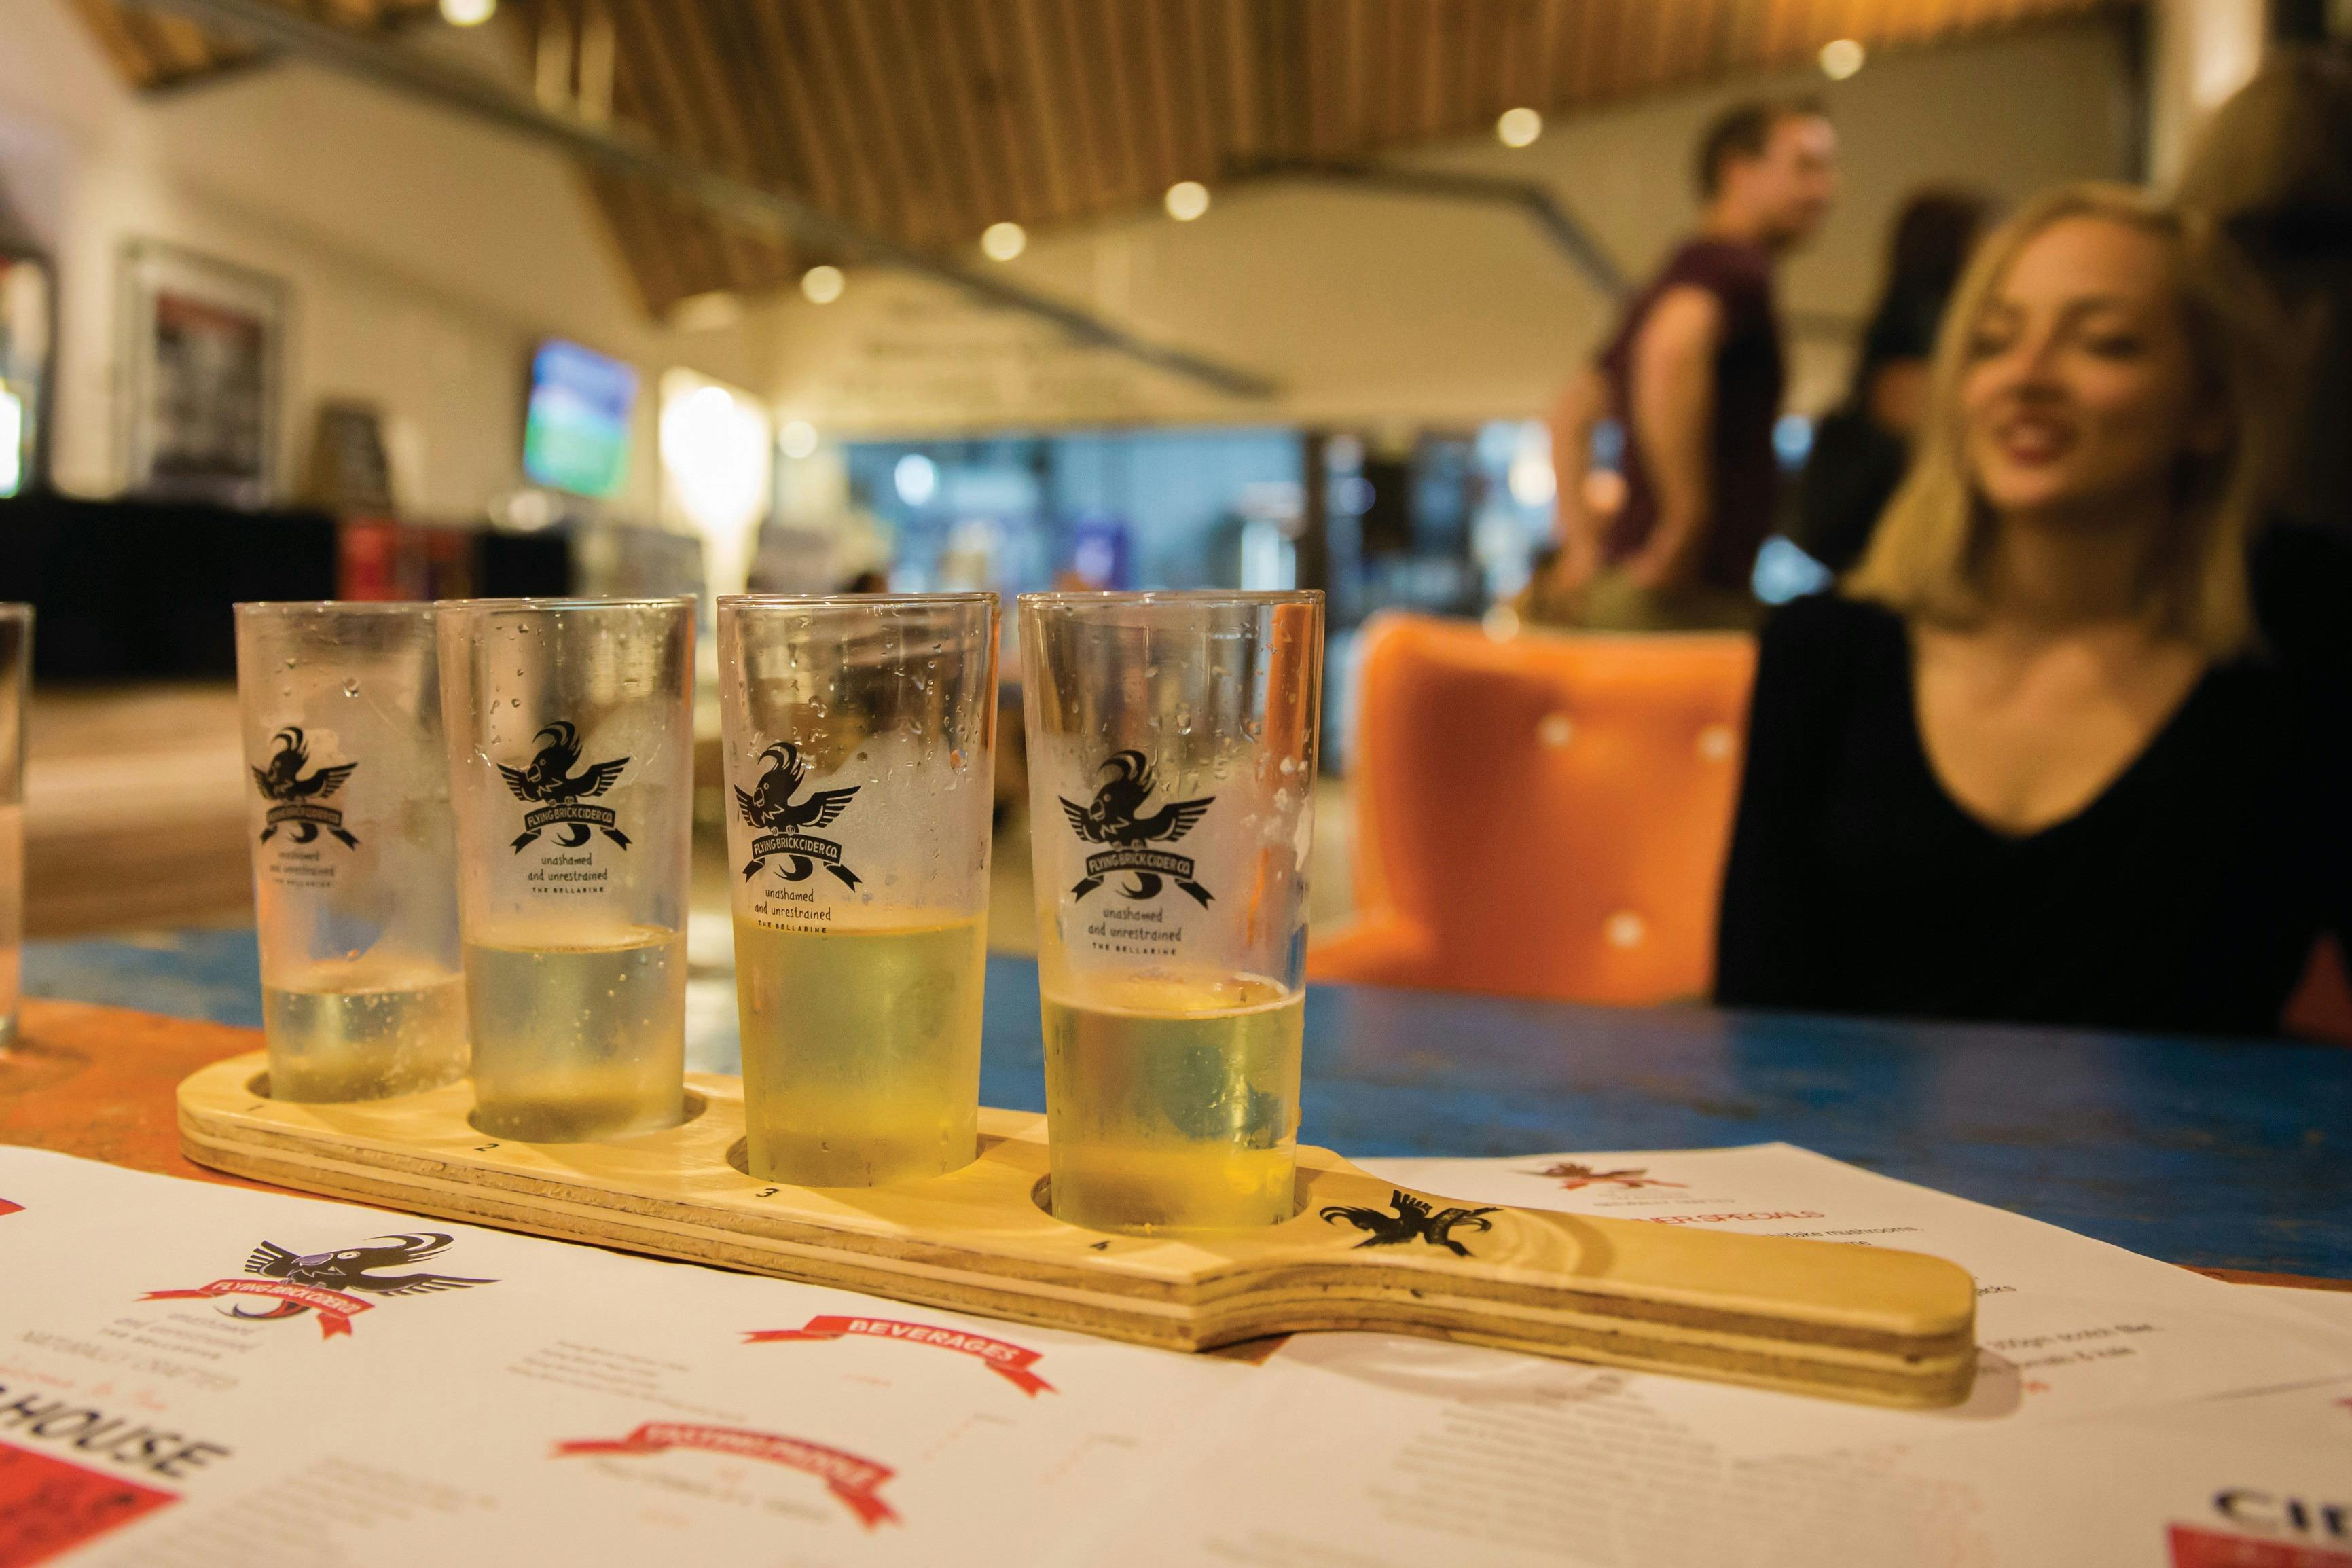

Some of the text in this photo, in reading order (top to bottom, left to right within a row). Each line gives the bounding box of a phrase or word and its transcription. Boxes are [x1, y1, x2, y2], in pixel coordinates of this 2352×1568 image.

[527, 809, 554, 827] FLYING
[554, 807, 577, 820] BRICK
[577, 808, 602, 821] CIDER
[754, 839, 776, 855] FLYING
[776, 837, 799, 850] BRICK
[799, 839, 826, 854] CIDER
[541, 852, 592, 866] unashamed
[1088, 854, 1119, 873] FLYING
[1146, 853, 1177, 871] CIDER
[528, 868, 608, 881] and unrestrained
[765, 887, 814, 903] unashamed
[755, 901, 831, 921] and unrestrained
[1103, 906, 1163, 923] unashamed
[758, 920, 827, 934] THE BELLARINE
[1088, 921, 1182, 942] and unrestrained
[473, 1143, 499, 1152] 2
[755, 1188, 780, 1197] 3
[1697, 1210, 1825, 1222] SPECIALS
[1089, 1240, 1112, 1250] 4
[212, 1281, 272, 1294] FLYING
[848, 1319, 1020, 1362] BEVERAGES
[0, 1391, 234, 1480] HOUSE
